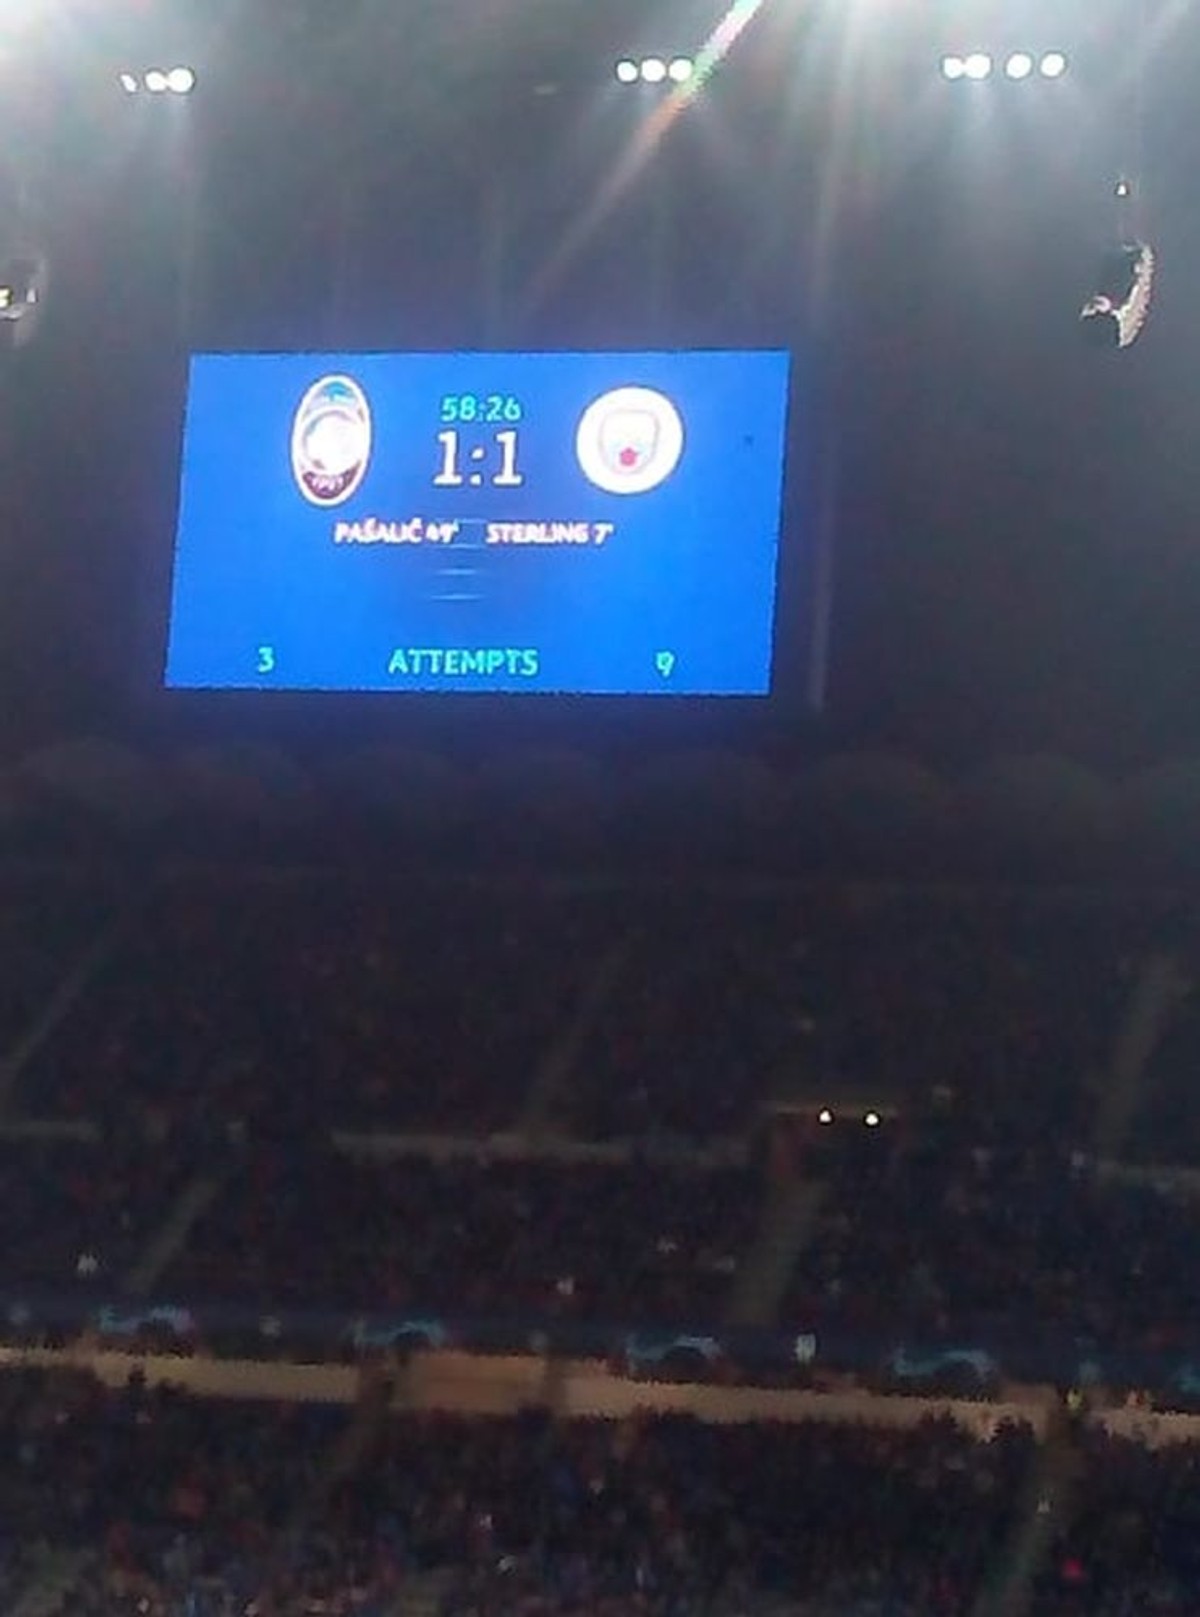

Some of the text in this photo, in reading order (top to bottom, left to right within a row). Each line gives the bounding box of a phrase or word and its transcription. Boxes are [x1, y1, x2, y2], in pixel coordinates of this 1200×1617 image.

[441, 394, 522, 423] 58:26
[432, 430, 524, 487] 1:1
[485, 521, 590, 544] STERLING
[257, 645, 676, 679] 3 ATTEMPTS 9
